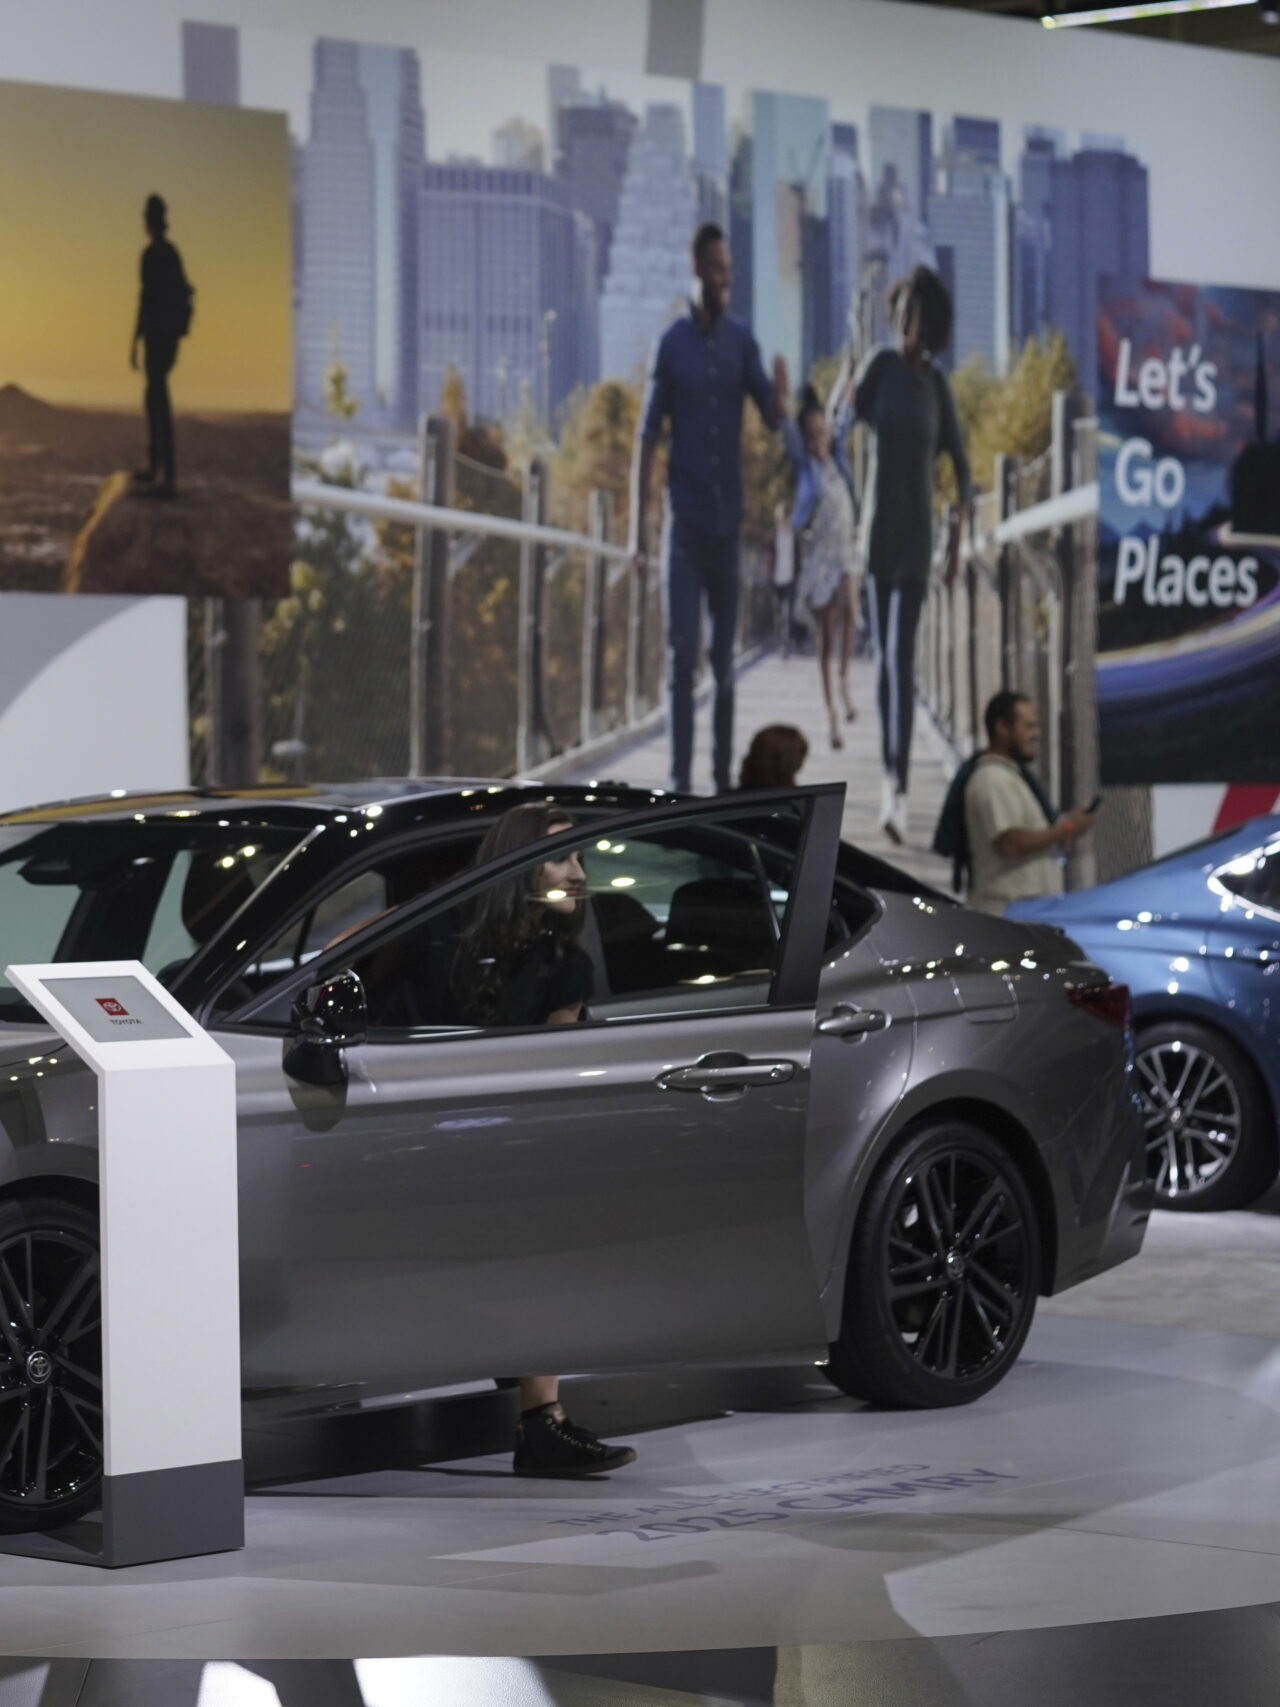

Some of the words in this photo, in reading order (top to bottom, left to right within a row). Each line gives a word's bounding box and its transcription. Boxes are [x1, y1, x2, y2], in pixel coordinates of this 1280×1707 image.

[1114, 337, 1219, 413] Let's
[1114, 435, 1186, 509] Go
[1114, 533, 1259, 607] Places
[110, 1018, 144, 1026] TOYOTA
[545, 1510, 642, 1527] THE
[595, 1508, 790, 1542] 2025
[776, 1468, 1020, 1511] CAMRY
